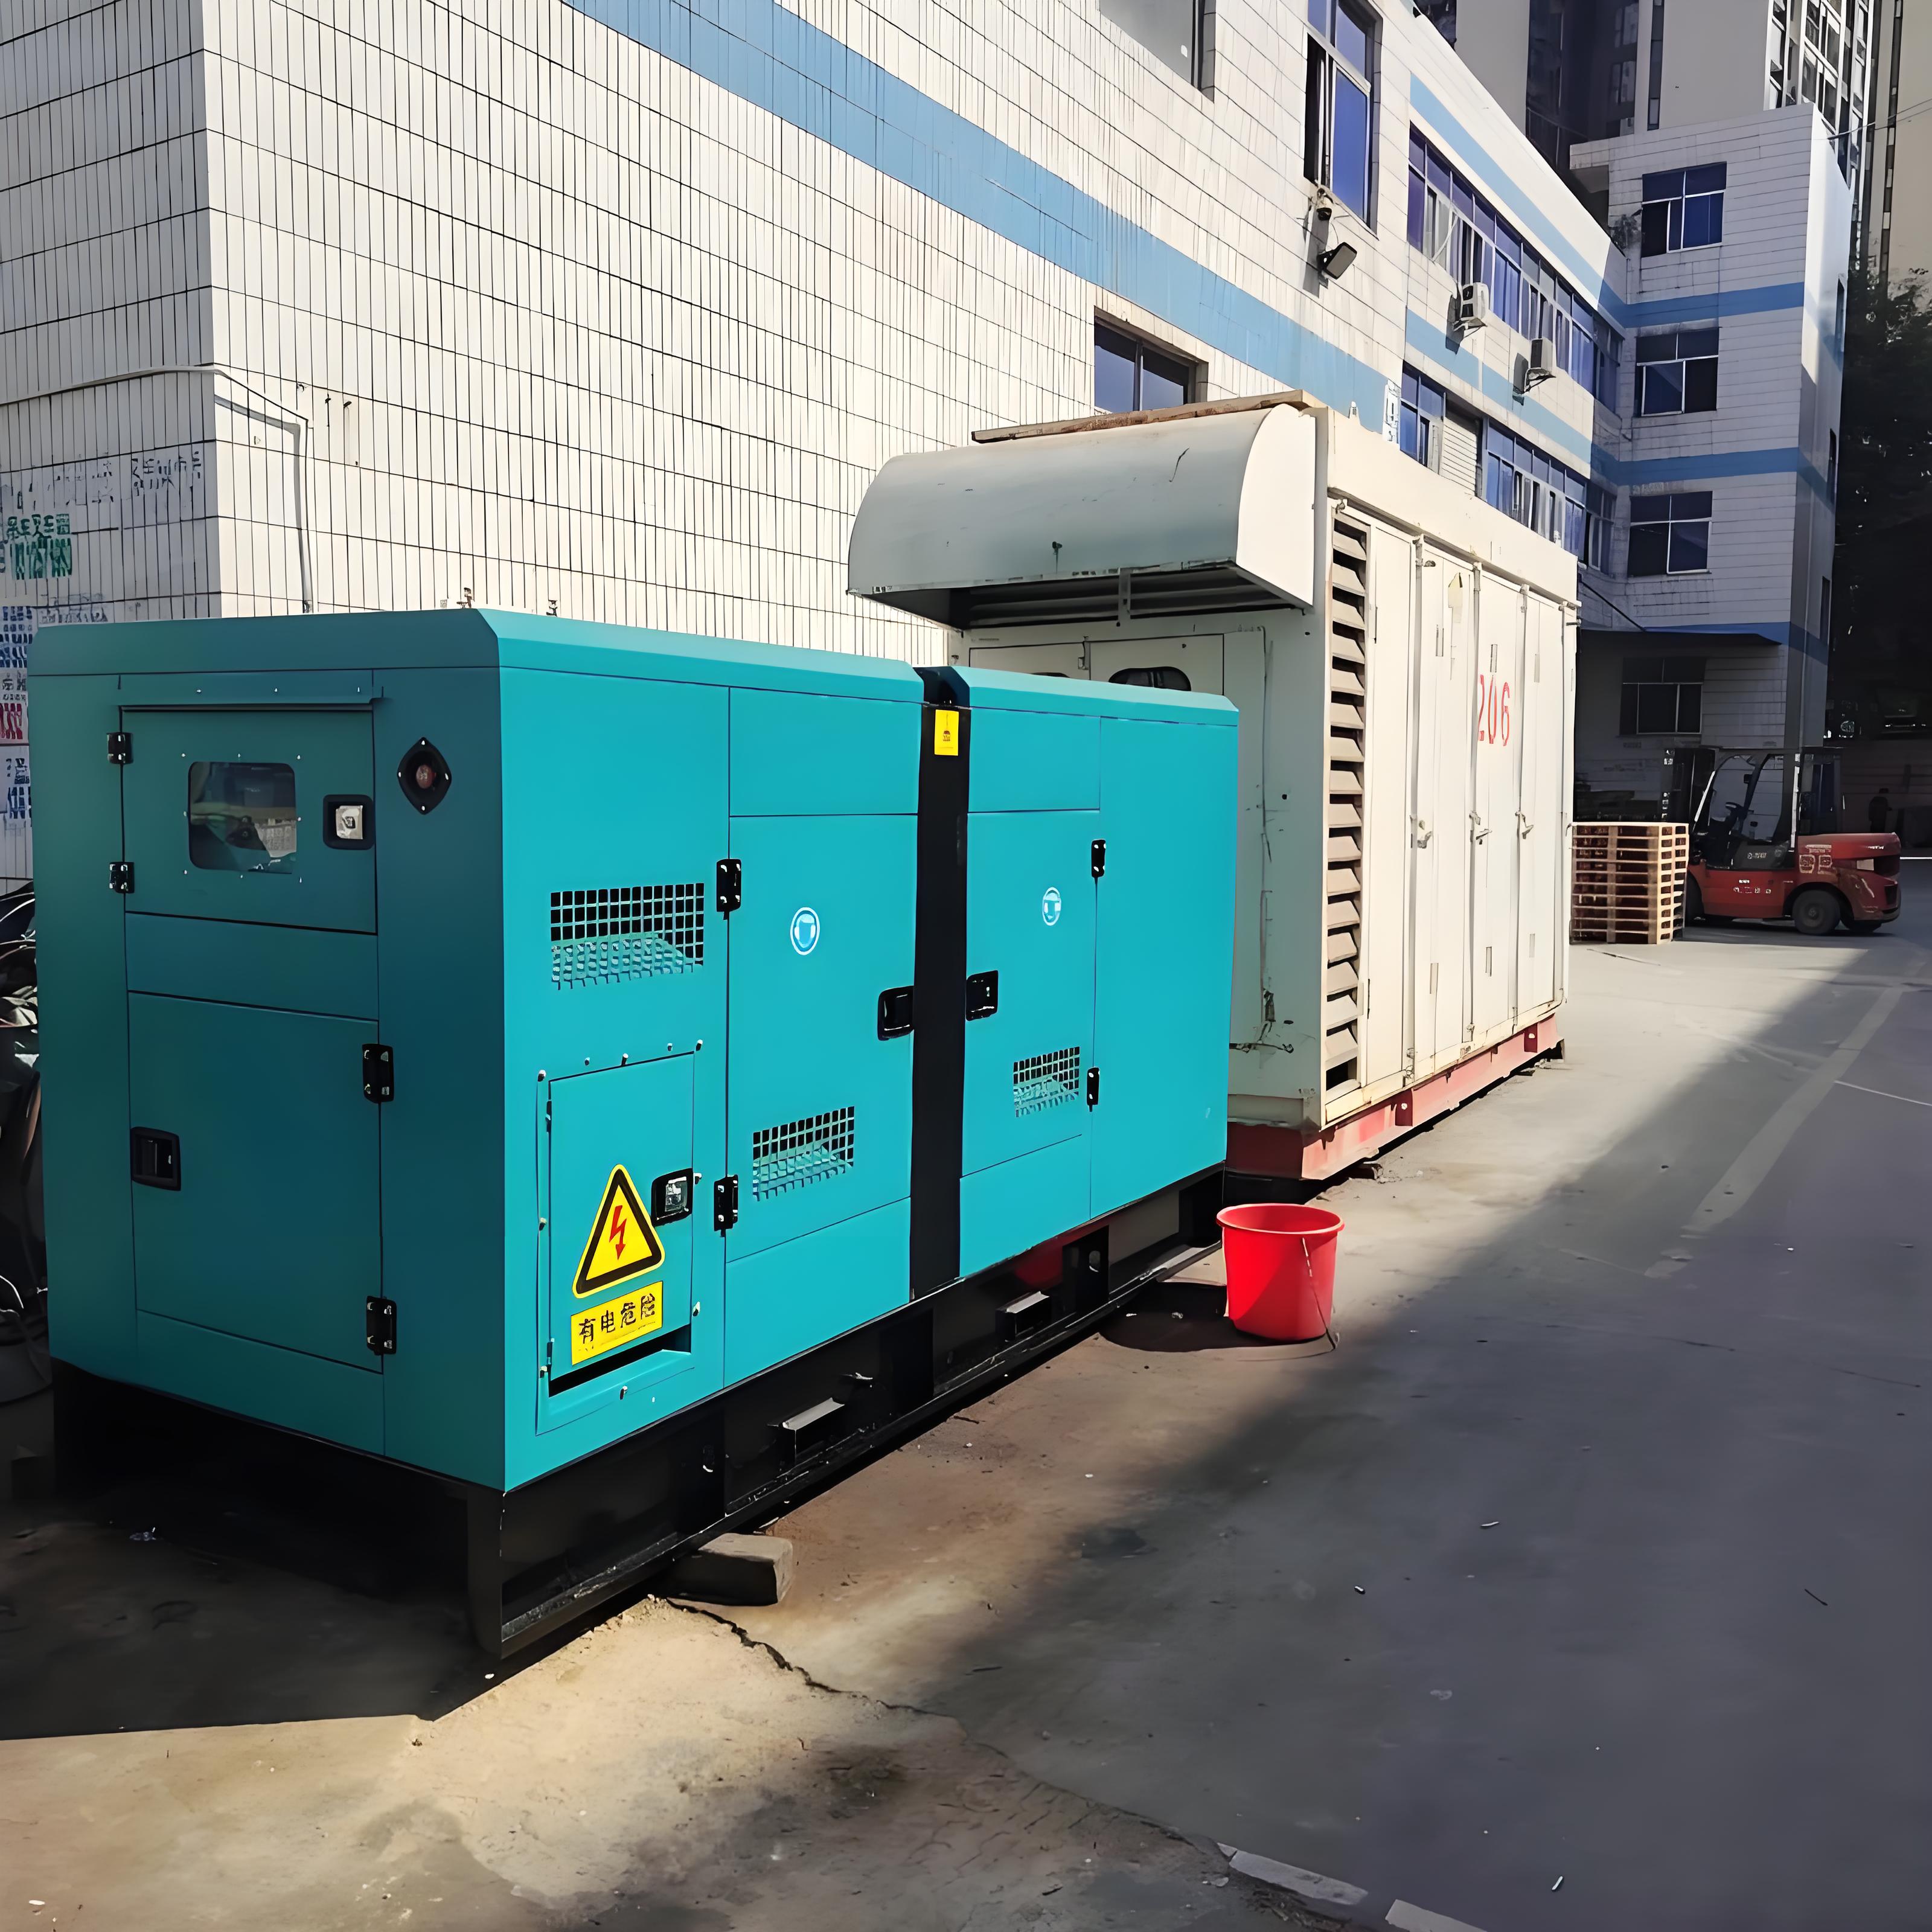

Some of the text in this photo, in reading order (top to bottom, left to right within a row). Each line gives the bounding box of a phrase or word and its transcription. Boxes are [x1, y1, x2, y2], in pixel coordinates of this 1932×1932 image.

[1478, 674, 1510, 746] 206
[578, 1293, 655, 1344] 有电危险
